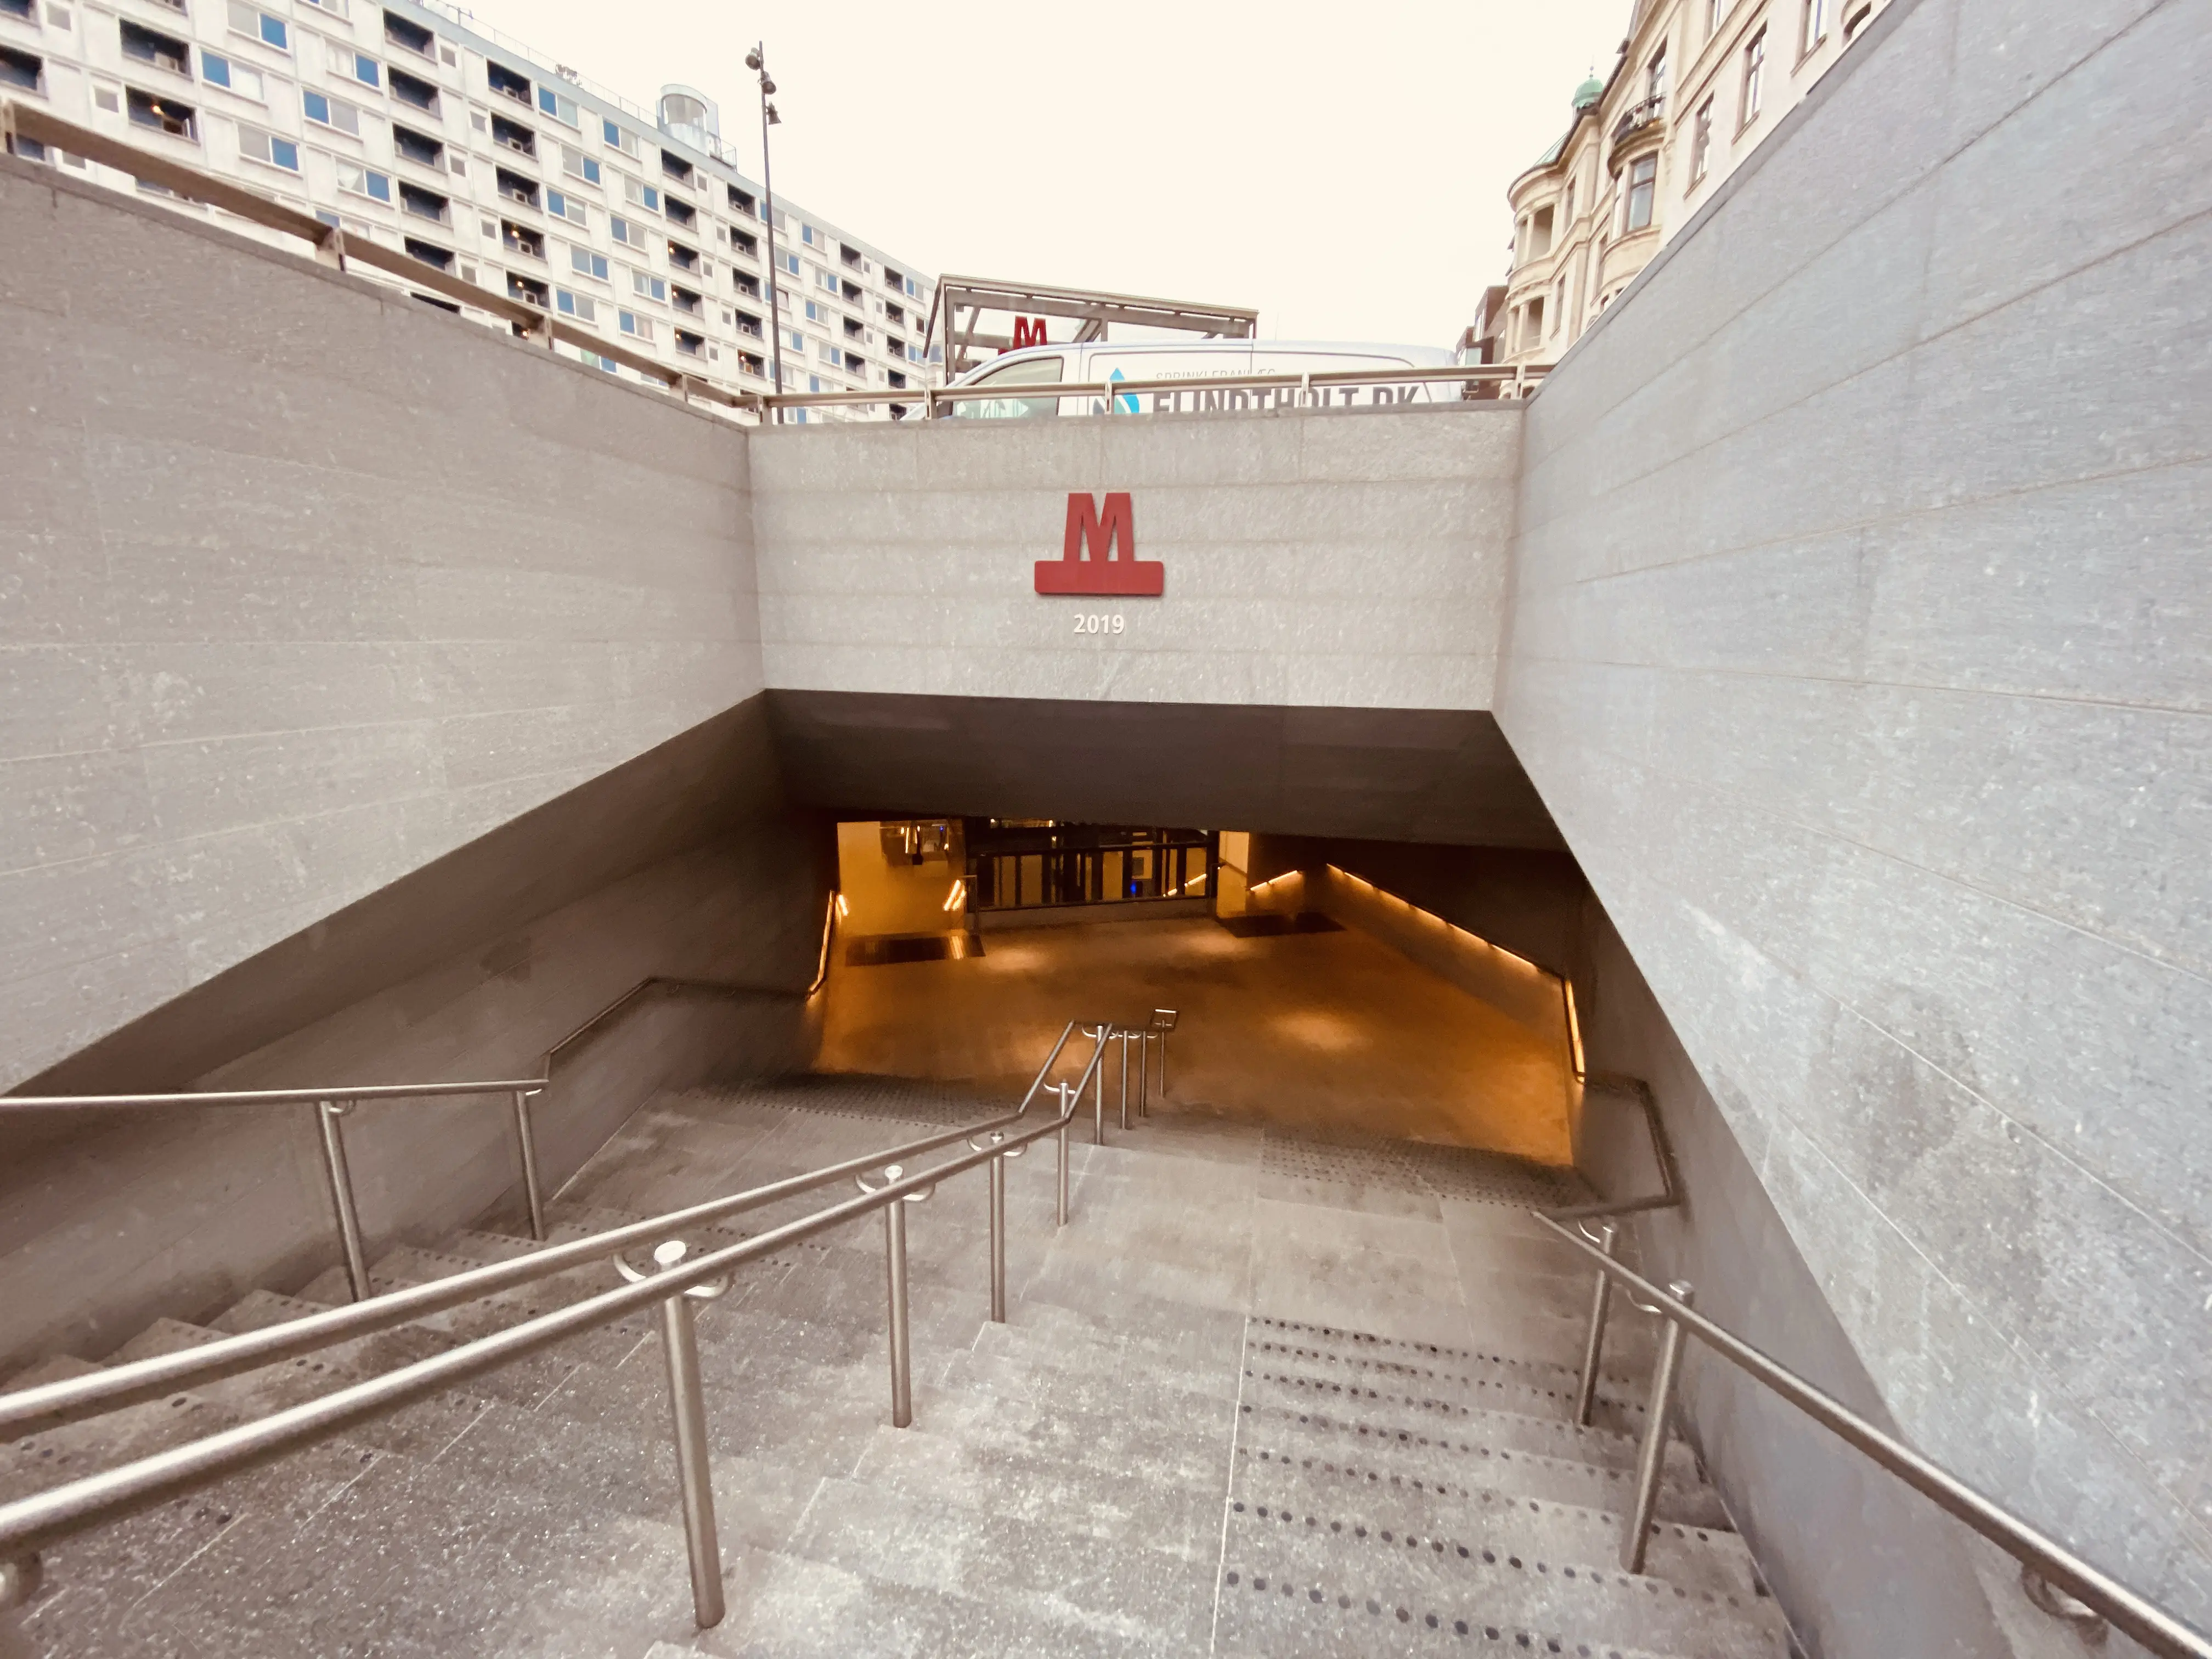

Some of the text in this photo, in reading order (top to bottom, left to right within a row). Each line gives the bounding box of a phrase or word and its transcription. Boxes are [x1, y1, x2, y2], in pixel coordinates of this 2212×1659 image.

[1013, 315, 1047, 350] M
[1063, 493, 1135, 562] M
[1073, 614, 1125, 634] 2019
